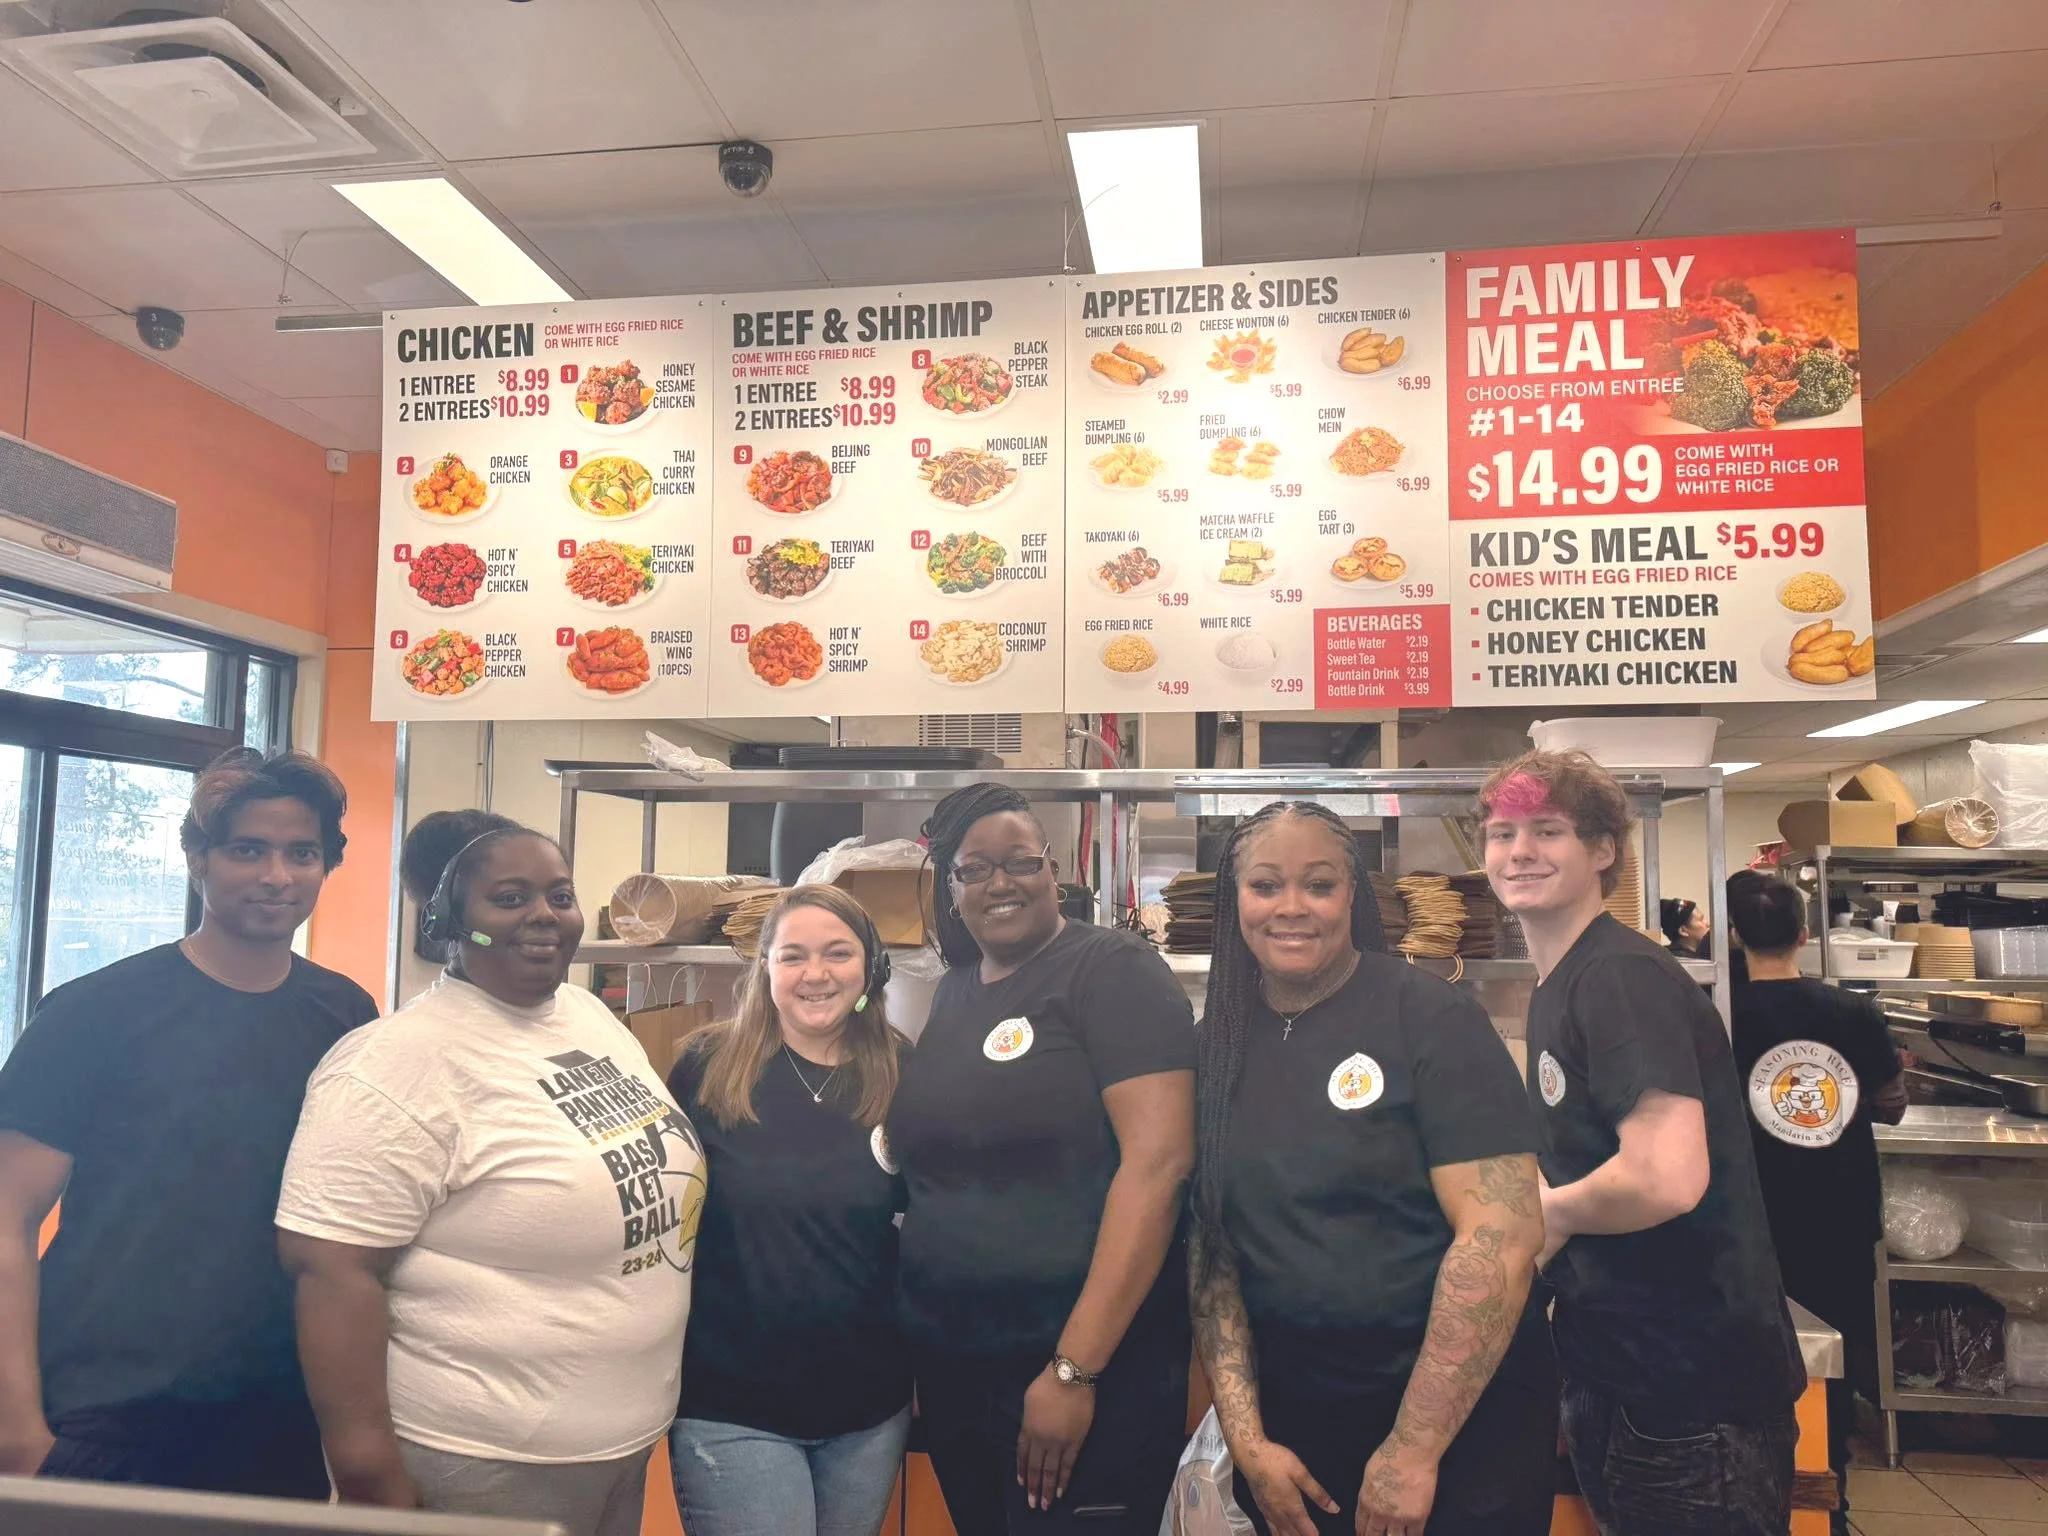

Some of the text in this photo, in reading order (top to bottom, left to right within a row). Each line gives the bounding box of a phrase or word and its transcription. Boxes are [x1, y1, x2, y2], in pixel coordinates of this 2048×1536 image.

[1466, 255, 1695, 319] FAMILY
[1082, 276, 1338, 319] APPETIZER & SIDES
[1318, 308, 1410, 323] CHICKEN TENDER (6)
[544, 319, 683, 336] COME WITH EGG FRIED RICE
[733, 300, 993, 347] BEEF & SHRIMP
[1085, 321, 1182, 338] CHICKEN EGG ROLL (2)
[1200, 315, 1289, 331] CHEESE WONTON (6)
[398, 323, 534, 362] CHICKEN
[544, 336, 619, 349] OR WHITE RICE
[1014, 341, 1048, 355] BLACK
[1467, 319, 1644, 377] MEAL
[663, 364, 695, 376] HONEY
[1008, 358, 1048, 372] PEPPER
[400, 374, 475, 396] 1 ENTREE
[499, 368, 549, 392] $8.99
[656, 380, 695, 393] SESAME
[1015, 374, 1048, 388] STEAK
[1398, 375, 1431, 390] $6.99
[1270, 383, 1302, 397] $5.99
[1466, 377, 1684, 402] CHOOSE FROM ENTREE
[653, 396, 695, 409] CHICKEN
[1158, 390, 1188, 404] $2.99
[399, 399, 490, 422] 2 ENTREES
[491, 394, 549, 418] $10.99
[1318, 408, 1346, 419] CHOW
[1468, 403, 1584, 437] #1-14
[1085, 419, 1126, 431] STEAMED
[1319, 421, 1342, 433] MEIN
[986, 436, 1048, 451] MONGOLIAN
[1085, 432, 1145, 445] DUMPLING (6)
[673, 451, 695, 462] THAI
[832, 445, 870, 458] BEIJING
[1675, 444, 1774, 461] COME WITH
[490, 455, 528, 468] ORANGE
[1023, 453, 1048, 466] BEEF
[663, 466, 695, 479] CURRY
[832, 461, 856, 474] BEEF
[1676, 458, 1839, 478] EGG FRIED RICE OR
[490, 470, 531, 484] CHICKEN
[1468, 445, 1662, 508] $14.99
[652, 482, 695, 495] CHICKEN
[1397, 476, 1430, 491] $6.99
[1676, 478, 1774, 495] WHITE RICE
[1158, 489, 1188, 503] $5.99
[1200, 512, 1274, 527] MATCHA WAFFLE
[1319, 510, 1336, 521] EGG
[1200, 527, 1262, 540] ICE CREAM (2)
[1319, 522, 1354, 535] TART (3)
[1022, 534, 1047, 546] BEEF
[1085, 531, 1139, 543] TAKOYAKI (6)
[1717, 522, 1824, 559] $5.99
[831, 540, 874, 553] TERIYAKI
[1592, 525, 1708, 564] MEAL
[488, 549, 506, 561] HOT
[652, 545, 694, 558] TERIYAKI
[1021, 550, 1047, 563] WITH
[652, 561, 694, 574] CHICKEN
[831, 556, 855, 569] BEEF
[488, 565, 514, 577] SPICY
[996, 567, 1046, 580] BROCCOLI
[1470, 565, 1737, 588] COMES WITH EGG FRIED RICE
[487, 580, 528, 593] CHICKEN
[1400, 583, 1434, 598] $5.99
[1158, 593, 1188, 607] $6.99
[1270, 589, 1302, 603] $5.99
[1487, 594, 1718, 622] CHICKEN TENDER
[1085, 618, 1153, 631] EGG FRIED RICE
[1200, 616, 1251, 629] WHITE RICE
[1328, 614, 1422, 632] BEVERAGES
[829, 628, 848, 640] HOT
[999, 623, 1047, 636] COCONUT
[486, 633, 517, 646] BLACK
[651, 631, 693, 644] BRAISED
[1328, 637, 1386, 650] Bottle Water
[1406, 635, 1428, 647] $2.19
[1488, 628, 1706, 655] HONEY CHICKEN
[829, 644, 858, 656] SPICY
[1006, 639, 1046, 652] SHRIMP
[485, 650, 521, 663] PEPPER
[666, 647, 692, 660] WING
[1327, 653, 1375, 665] Sweet Tea
[1407, 651, 1428, 663] $2.19
[484, 665, 526, 678] CHICKEN
[658, 664, 692, 676] (10PCS)
[829, 660, 868, 672] SHRIMP
[1328, 667, 1399, 681] Fountain Drink
[1407, 667, 1428, 679] $2.19
[1488, 660, 1737, 688] TERIYAKI CHICKEN
[1158, 681, 1189, 695] $4.99
[1271, 679, 1303, 692] $2.99
[1328, 684, 1385, 696] Bottle Drink
[1404, 683, 1429, 695] $3.99
[1756, 1045, 1852, 1092] SEASONING RICE
[557, 1074, 652, 1127] PANTHERS
[1769, 1119, 1811, 1141] Mandarin
[601, 1138, 659, 1183] BAS
[616, 1167, 665, 1217] KET
[624, 1197, 681, 1250] BALL
[622, 1250, 662, 1276] 23-24
